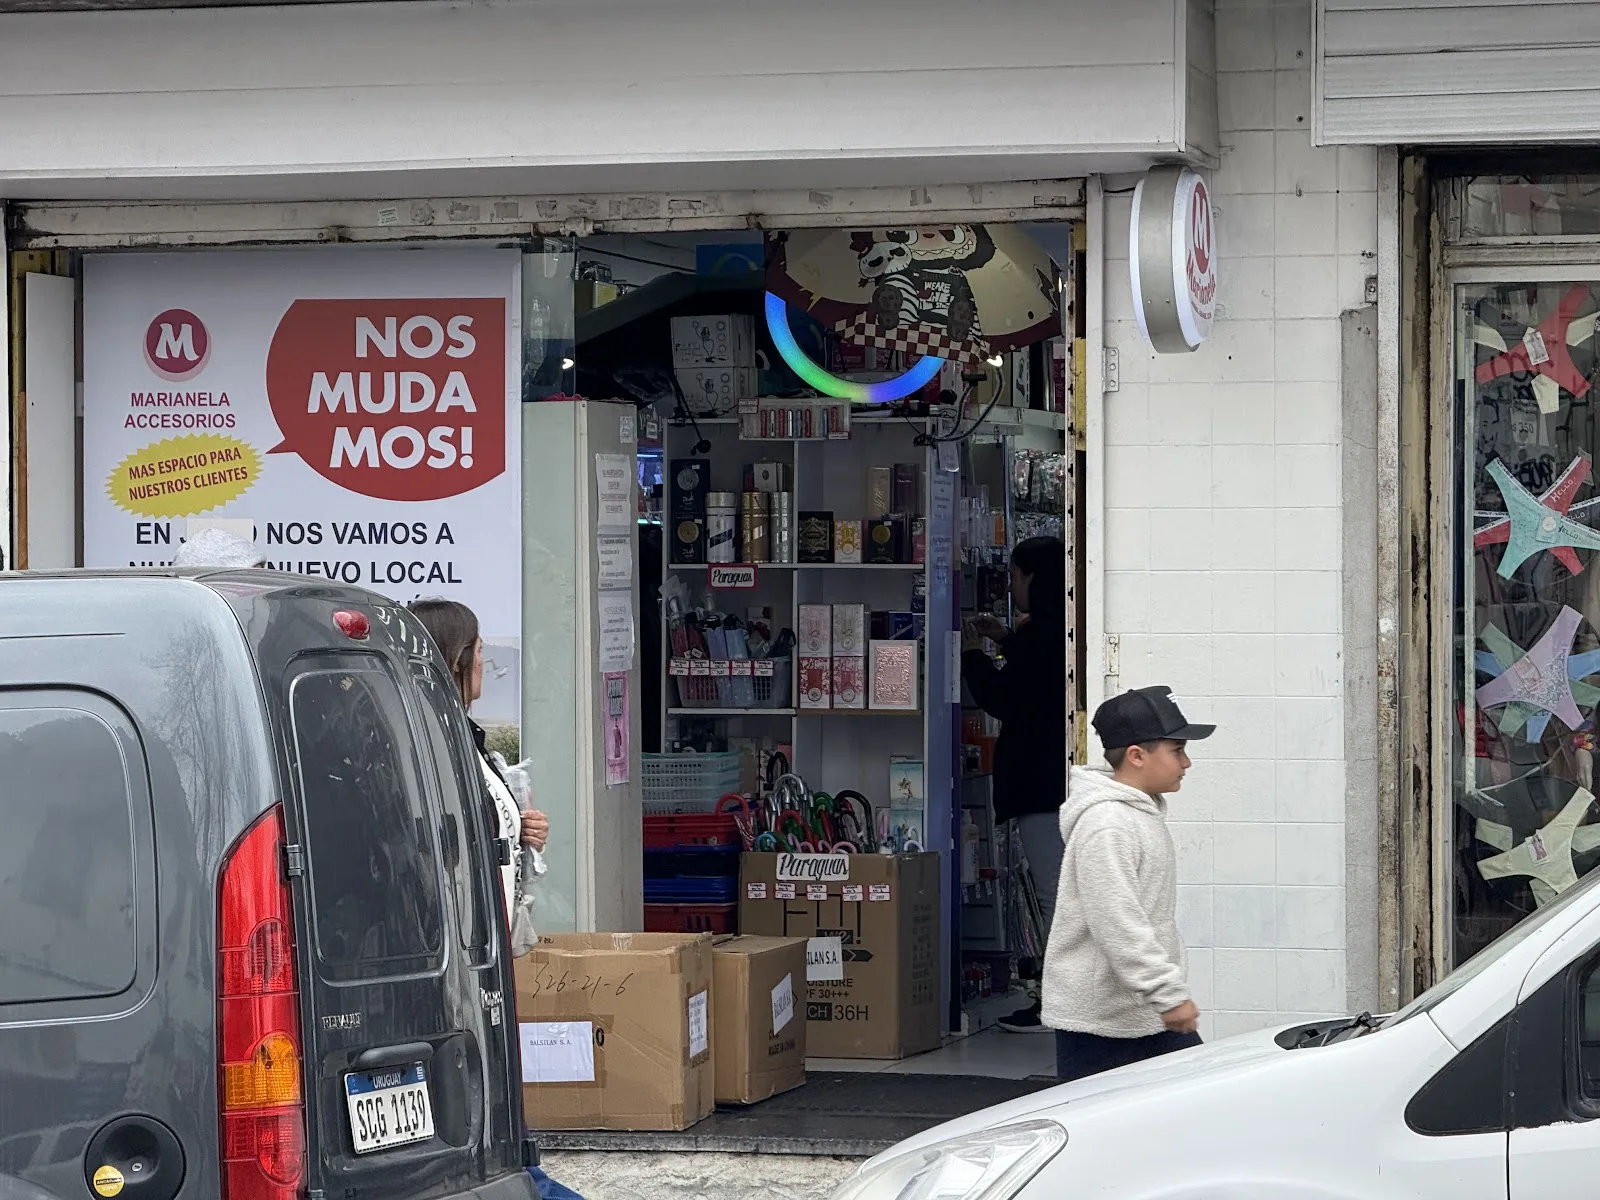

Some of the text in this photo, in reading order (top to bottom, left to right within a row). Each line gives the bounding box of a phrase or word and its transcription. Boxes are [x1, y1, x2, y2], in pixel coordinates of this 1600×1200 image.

[155, 322, 200, 362] M
[355, 314, 477, 359] NOS
[130, 392, 231, 407] MARIANELA
[307, 370, 478, 414] MUDA
[124, 413, 236, 429] ACCESORIOS
[329, 425, 474, 470] MOS!
[128, 447, 242, 480] MAS ESPACIO PARA
[128, 466, 249, 501] NUESTROS CLIENTES
[1550, 480, 1575, 503] HELLO
[136, 522, 171, 544] EN
[266, 522, 323, 545] NOS
[331, 522, 429, 545] VAMOS
[435, 522, 455, 544] A
[370, 561, 462, 584] LOCAL
[712, 569, 754, 588] Paraguas
[778, 853, 849, 881] Paraguas
[807, 951, 825, 965] ILAN
[835, 1004, 869, 1022] 36H
[372, 1072, 402, 1089] URUGUAY
[356, 1089, 427, 1142] SCG 1139
